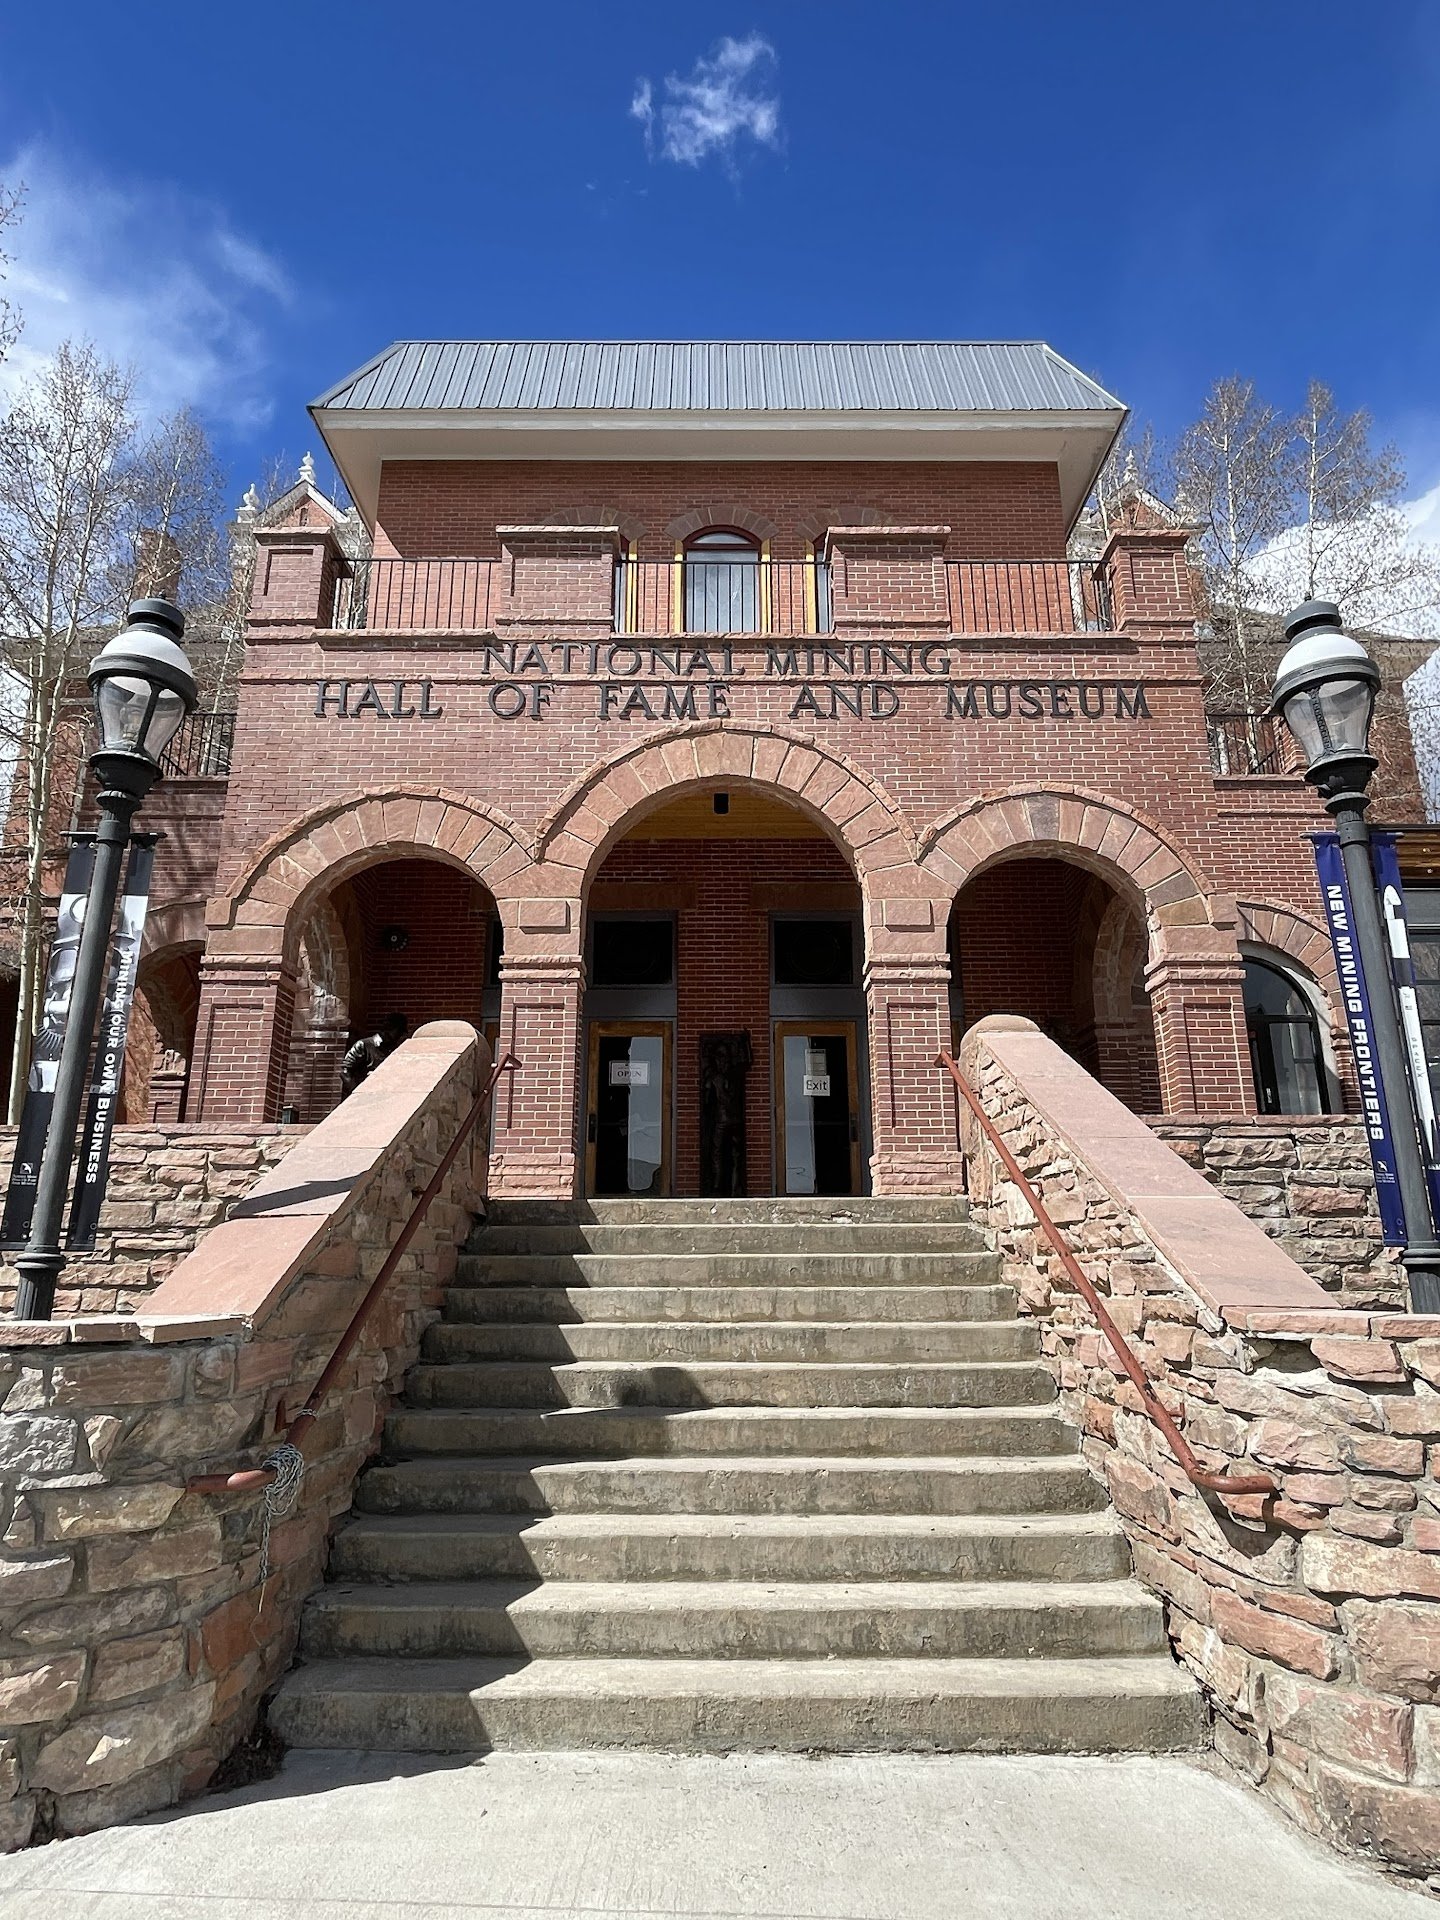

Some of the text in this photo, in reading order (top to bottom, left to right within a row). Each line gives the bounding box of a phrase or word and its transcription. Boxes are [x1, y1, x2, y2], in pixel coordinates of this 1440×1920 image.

[481, 642, 951, 675] NATIONAL MINING
[314, 681, 1153, 721] HALL OF FAME AND MUSEUM
[1326, 884, 1384, 1140] NEW MINING FRONTIERS
[85, 950, 135, 1184] MINING OUR OWN BUSINESS
[617, 1070, 642, 1078] OPEN
[806, 1079, 828, 1091] Exit
